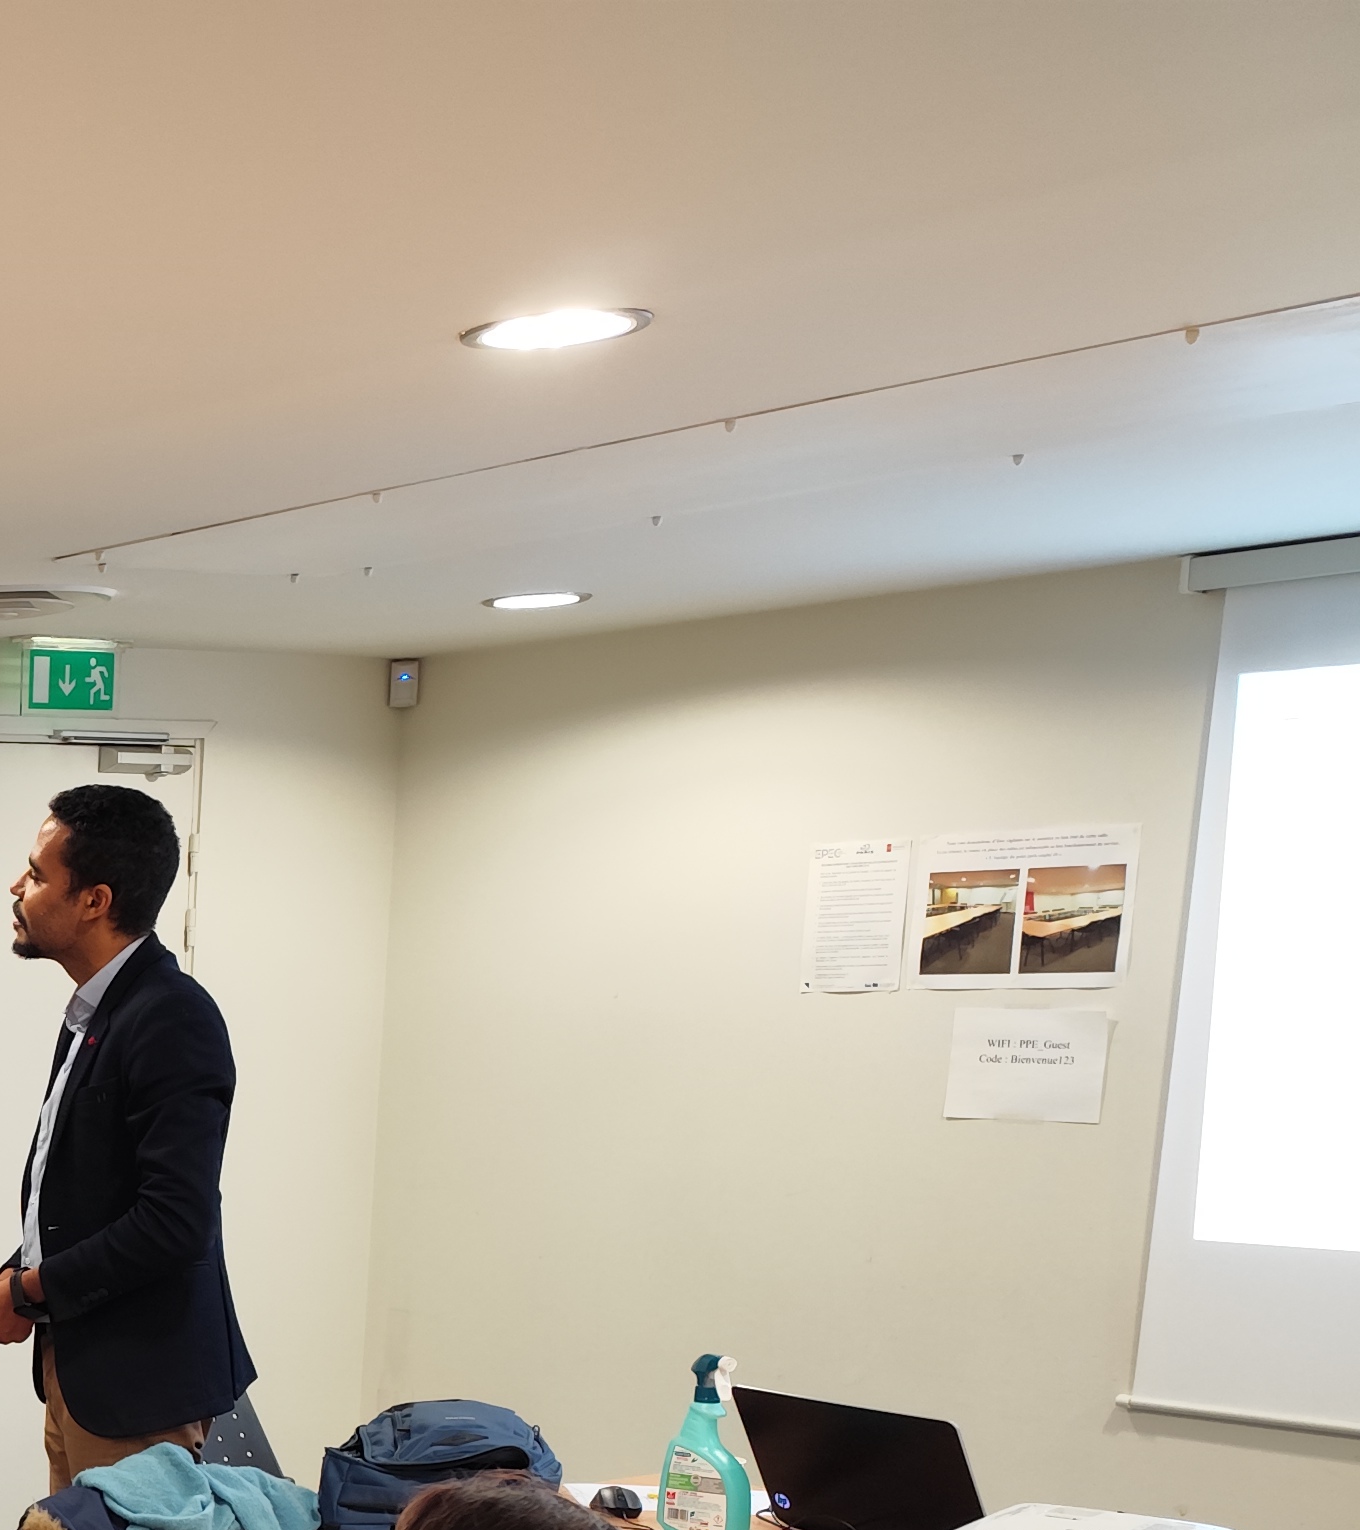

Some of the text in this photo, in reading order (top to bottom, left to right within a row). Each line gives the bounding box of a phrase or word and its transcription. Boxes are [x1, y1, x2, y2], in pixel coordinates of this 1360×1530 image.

[988, 1039, 1011, 1048] WIFI
[1019, 1039, 1071, 1051] PPE_Guest
[979, 1053, 1002, 1064] Code
[1010, 1055, 1075, 1065] Bienvenue123
